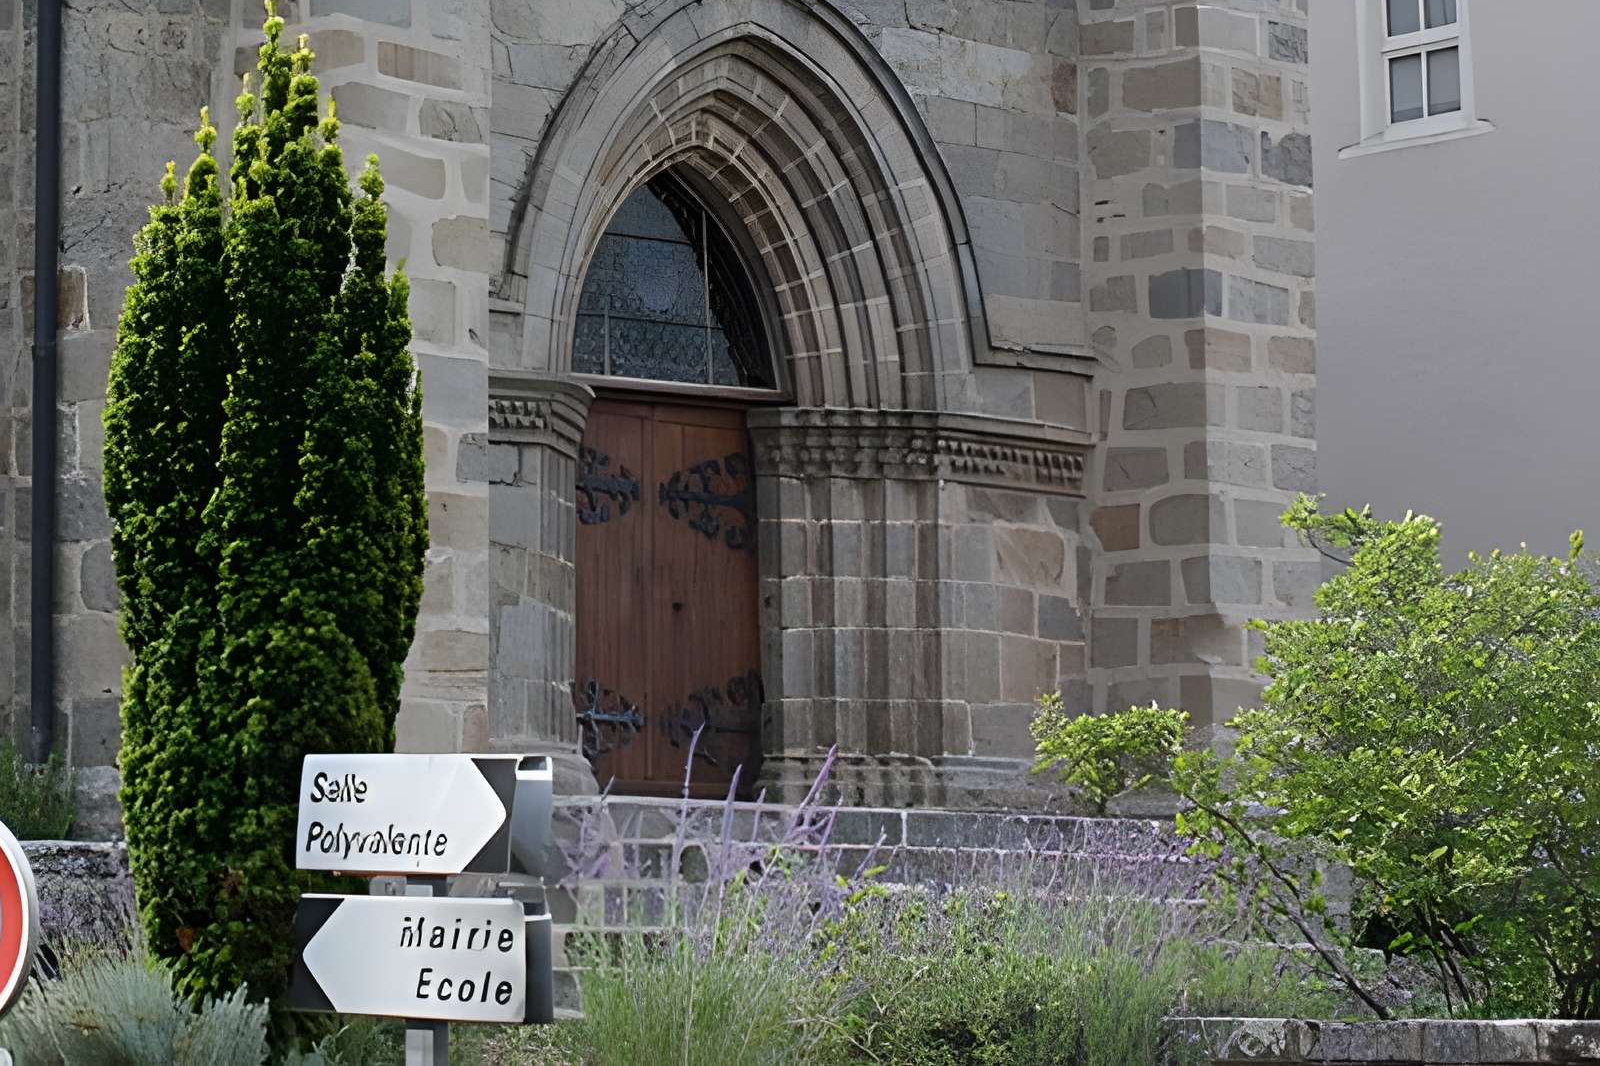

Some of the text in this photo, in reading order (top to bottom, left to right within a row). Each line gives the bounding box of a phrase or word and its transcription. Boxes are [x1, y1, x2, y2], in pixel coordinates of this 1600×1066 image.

[310, 772, 368, 804] Salle
[305, 821, 448, 860] Polyvalente
[399, 916, 514, 952] Mairie
[415, 967, 513, 1005] Ecole
